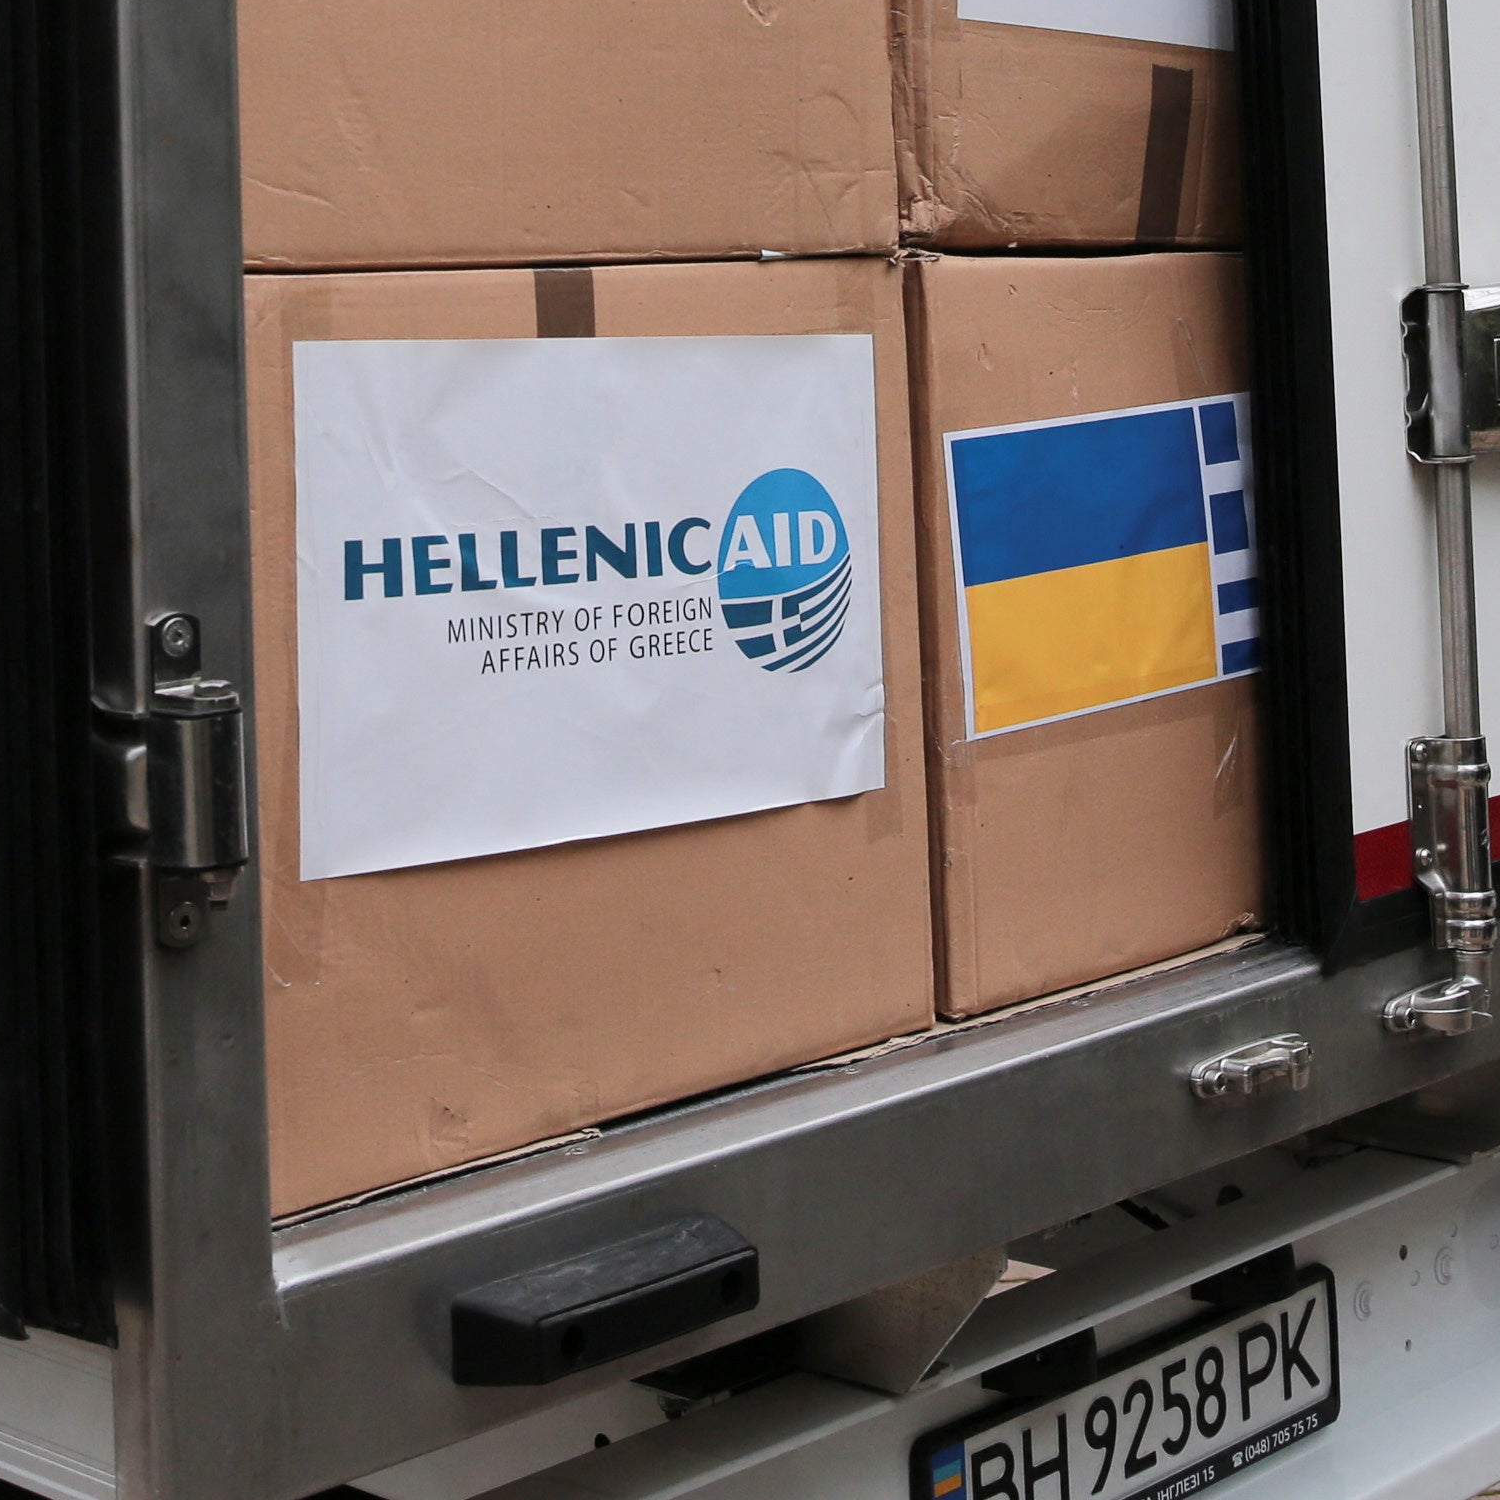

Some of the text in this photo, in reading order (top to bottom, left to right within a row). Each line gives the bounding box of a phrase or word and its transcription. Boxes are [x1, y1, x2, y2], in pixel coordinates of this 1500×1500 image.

[344, 509, 838, 601] HELLENIC AID
[447, 596, 713, 645] MINISTRY OF FOREIGN
[481, 627, 714, 675] AFFAIRS OF GREECE
[1084, 1345, 1228, 1496] 9258
[1236, 1297, 1321, 1423] PK
[1245, 1413, 1319, 1463] (048) 705 75 75
[1202, 1465, 1215, 1482] 15
